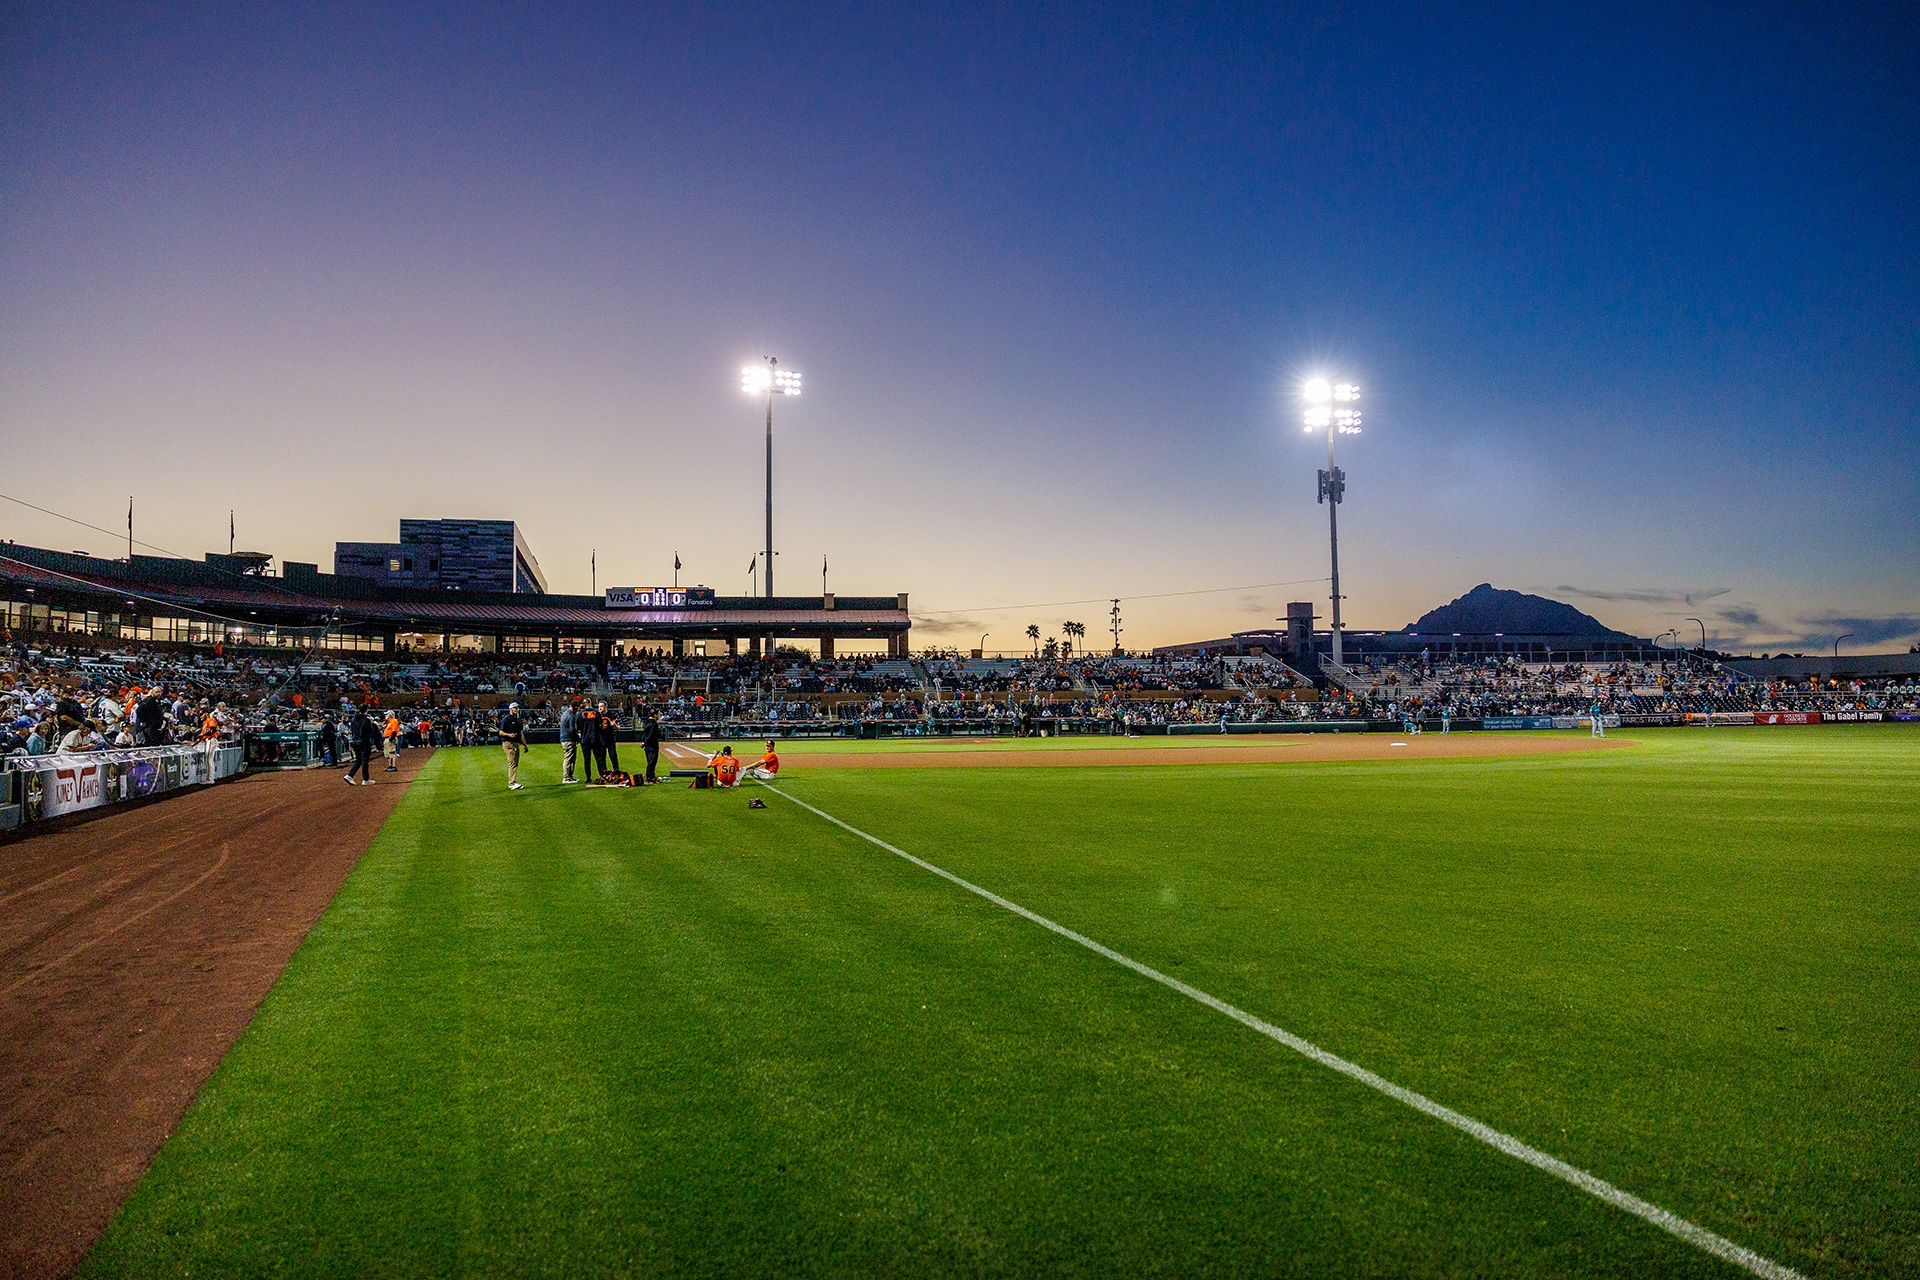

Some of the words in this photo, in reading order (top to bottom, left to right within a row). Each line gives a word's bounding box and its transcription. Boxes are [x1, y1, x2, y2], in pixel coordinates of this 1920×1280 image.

[609, 593, 634, 602] VISA
[641, 593, 650, 604] 0
[672, 593, 681, 604] 0
[1823, 712, 1836, 720] The
[1837, 712, 1858, 720] Gabel
[1859, 711, 1883, 721] Family
[721, 764, 736, 775] 50
